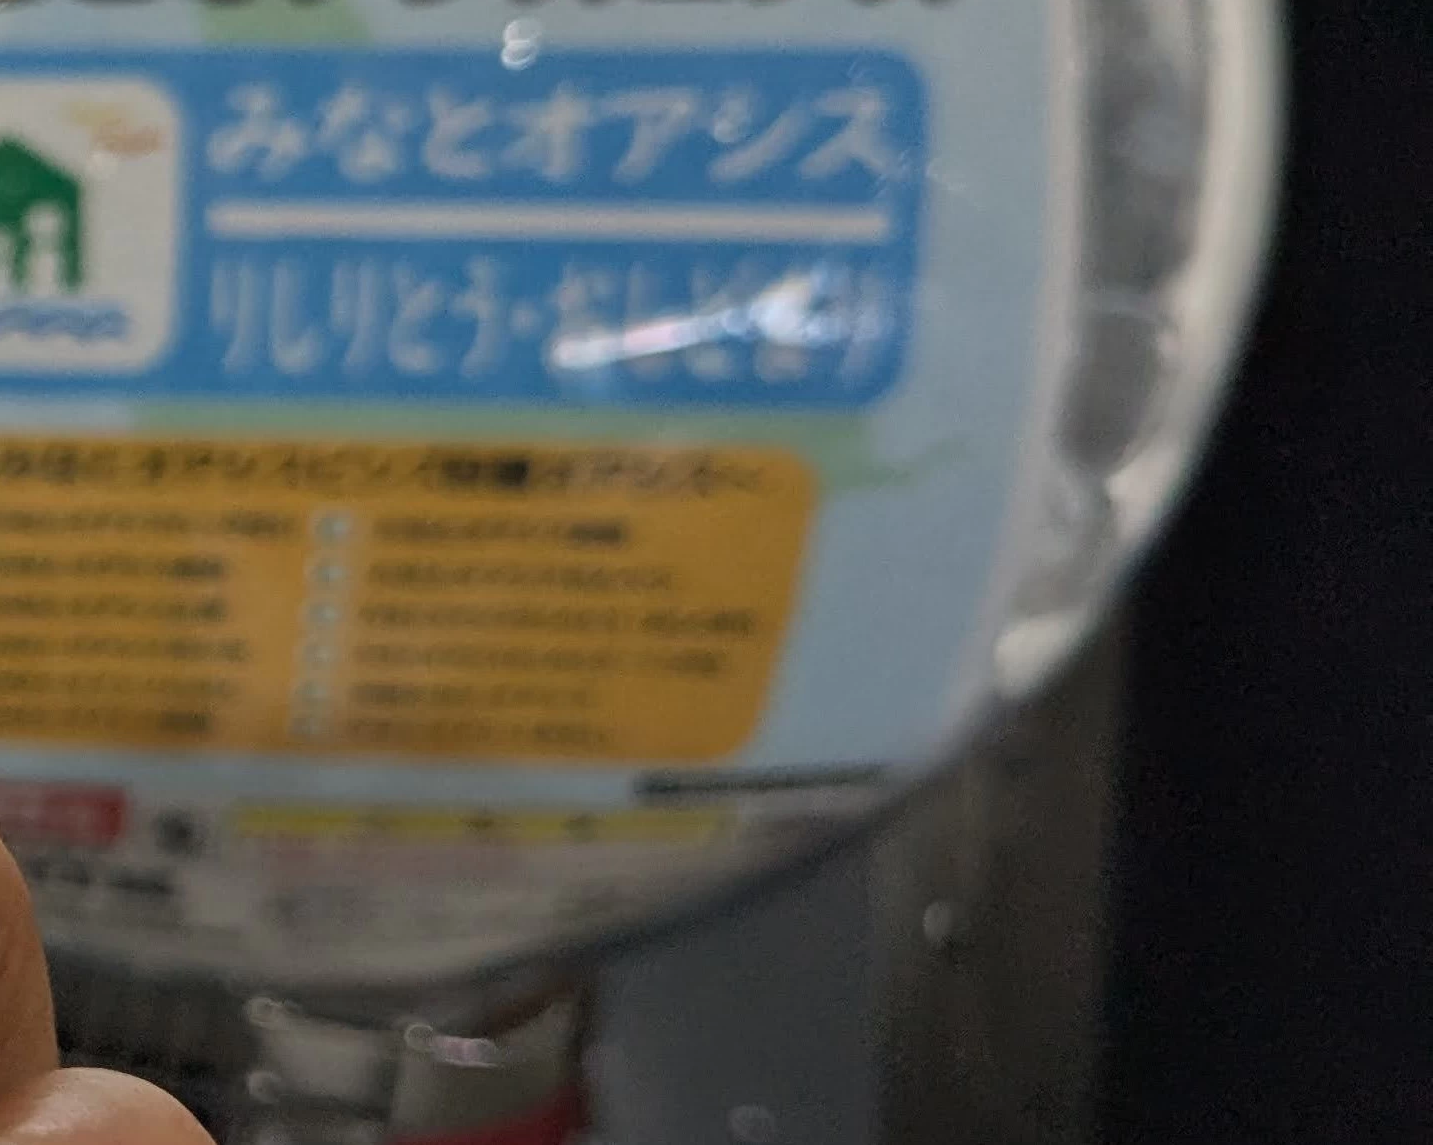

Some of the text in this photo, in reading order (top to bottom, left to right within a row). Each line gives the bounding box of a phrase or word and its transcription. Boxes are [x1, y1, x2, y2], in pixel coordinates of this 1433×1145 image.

[206, 82, 902, 182] みなとオアシス
